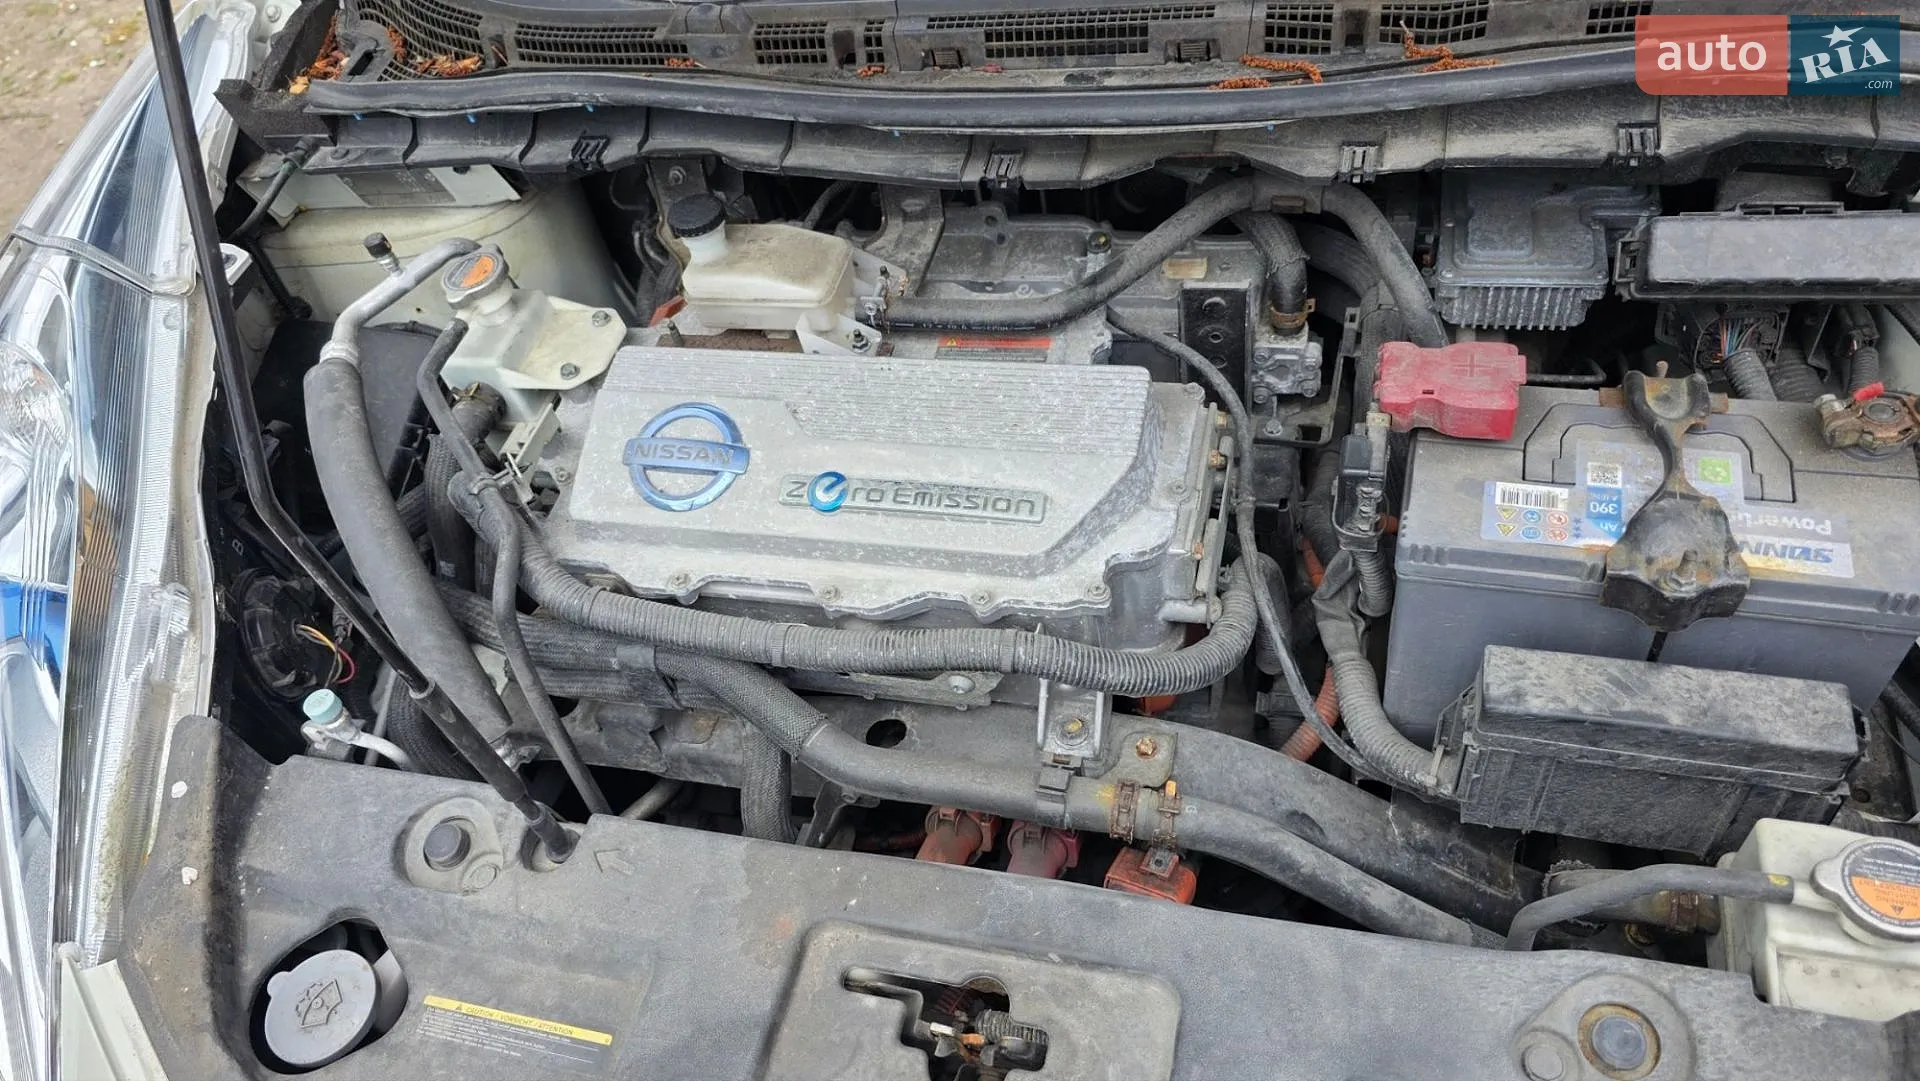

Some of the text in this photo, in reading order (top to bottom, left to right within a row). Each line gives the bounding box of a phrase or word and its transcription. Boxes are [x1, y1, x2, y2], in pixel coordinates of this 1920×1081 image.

[634, 443, 735, 466] NISSAN
[892, 486, 1036, 517] Emission
[1589, 502, 1619, 515] 390
